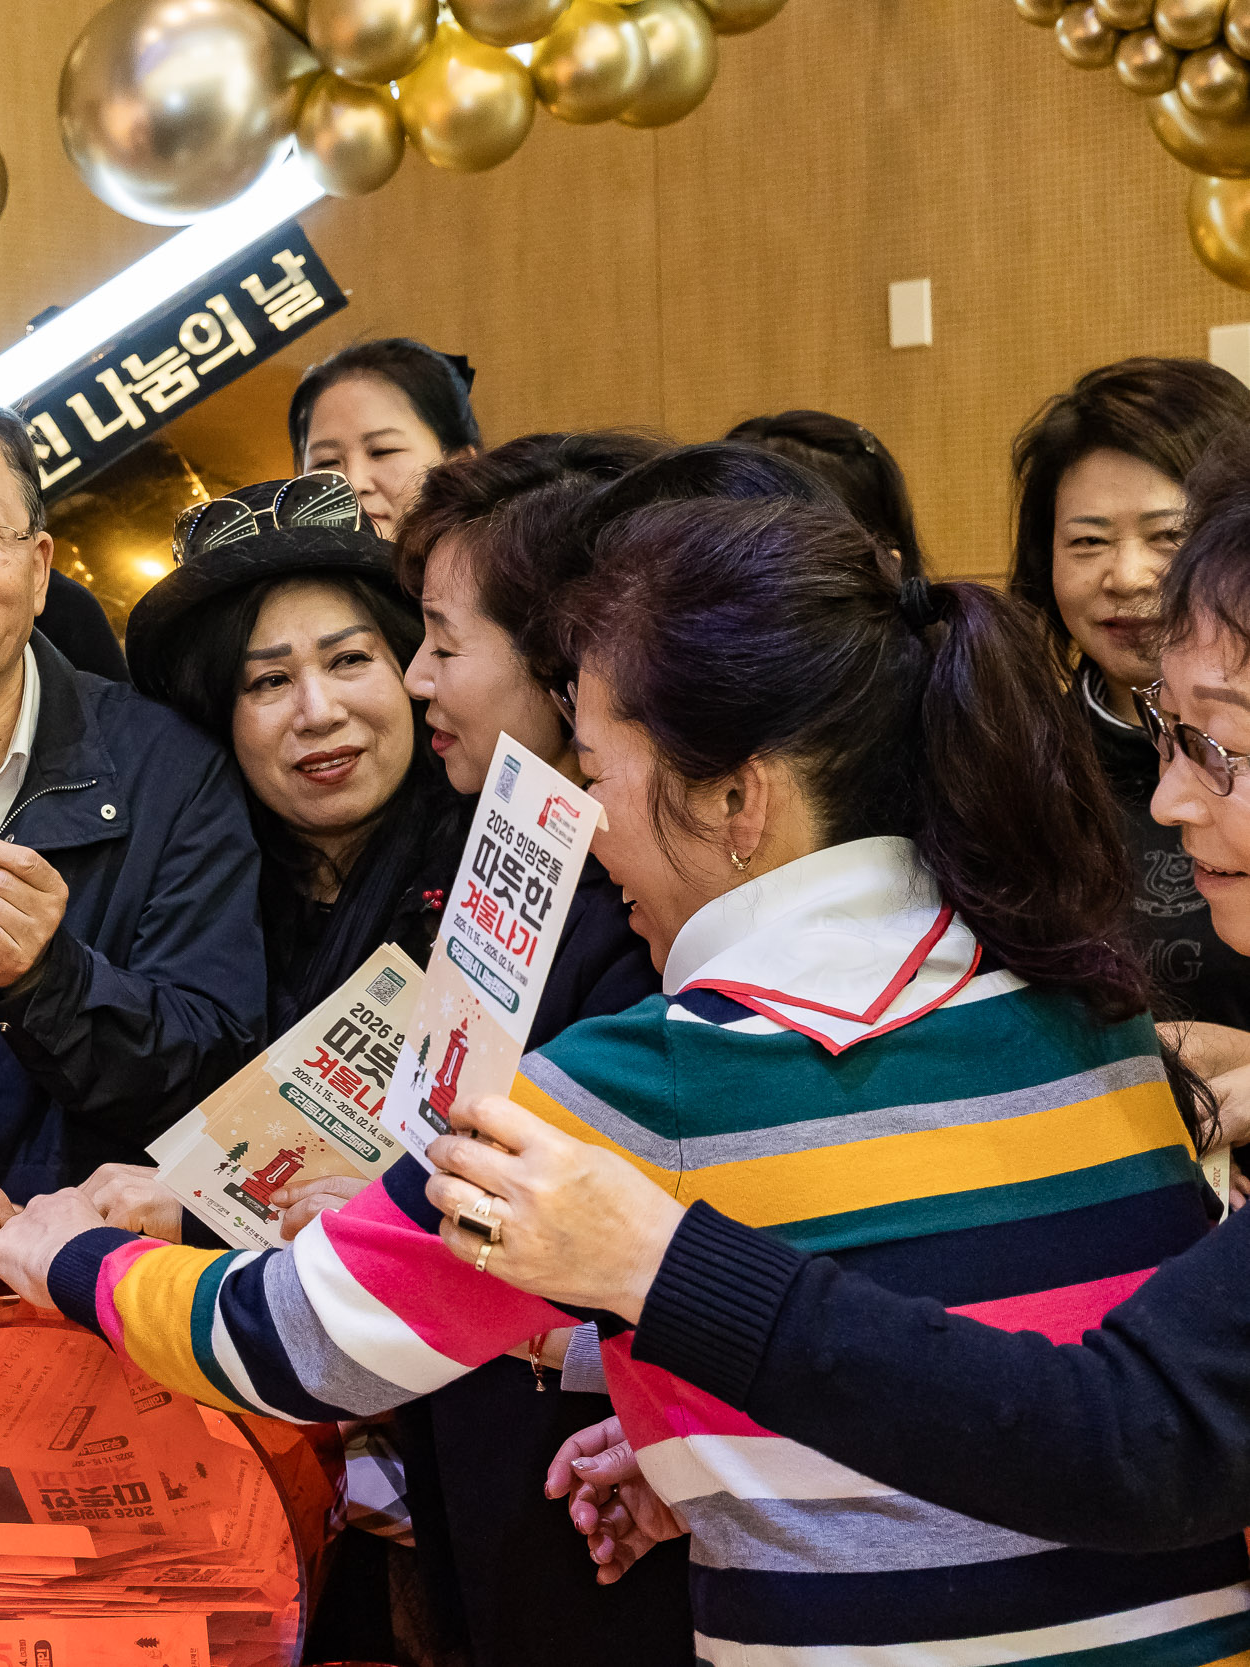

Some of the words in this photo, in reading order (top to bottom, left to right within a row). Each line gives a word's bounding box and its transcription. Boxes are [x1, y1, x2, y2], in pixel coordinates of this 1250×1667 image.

[66, 293, 257, 442] 나눔의
[239, 248, 325, 332] 날
[472, 833, 553, 932] 따뜻한
[486, 809, 515, 845] 2026
[513, 832, 564, 886] 희망온돌
[460, 880, 538, 967] 겨울나기
[349, 1002, 393, 1039] 2026
[303, 1045, 386, 1120] 겨울나
[38, 1481, 152, 1510] 따뜻한
[114, 1505, 155, 1519] 2026
